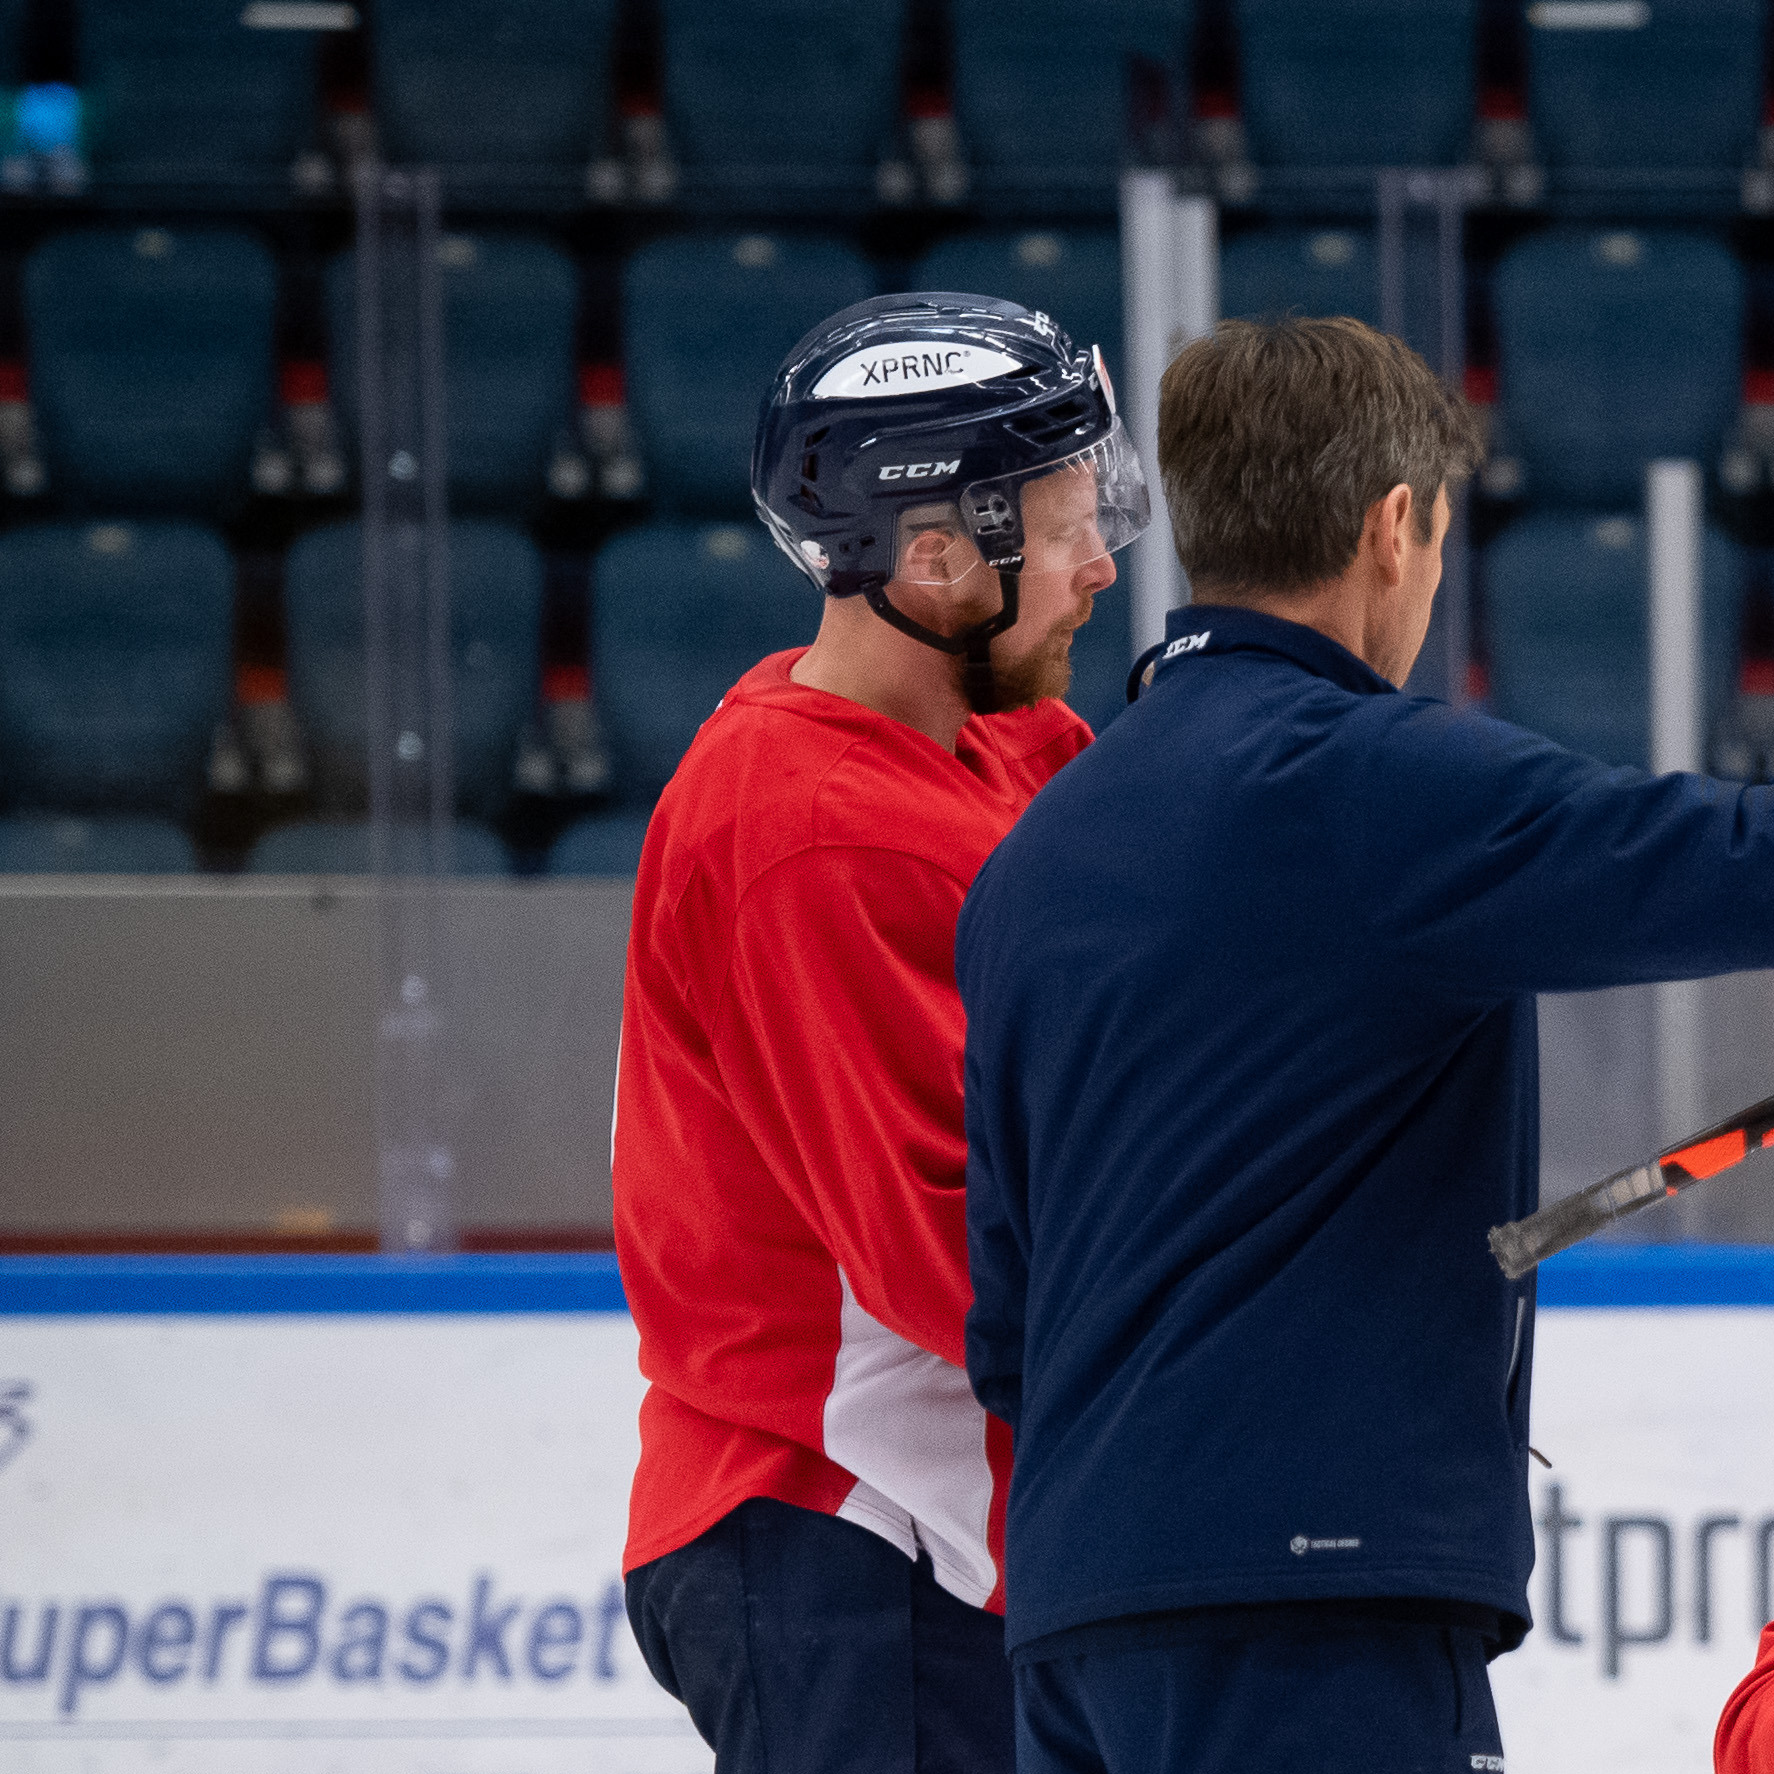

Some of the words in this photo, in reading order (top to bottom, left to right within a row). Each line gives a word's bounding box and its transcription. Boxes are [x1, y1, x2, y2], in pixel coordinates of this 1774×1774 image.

[860, 351, 964, 386] XPRNC
[878, 459, 961, 481] CCM
[989, 555, 1022, 567] CCM
